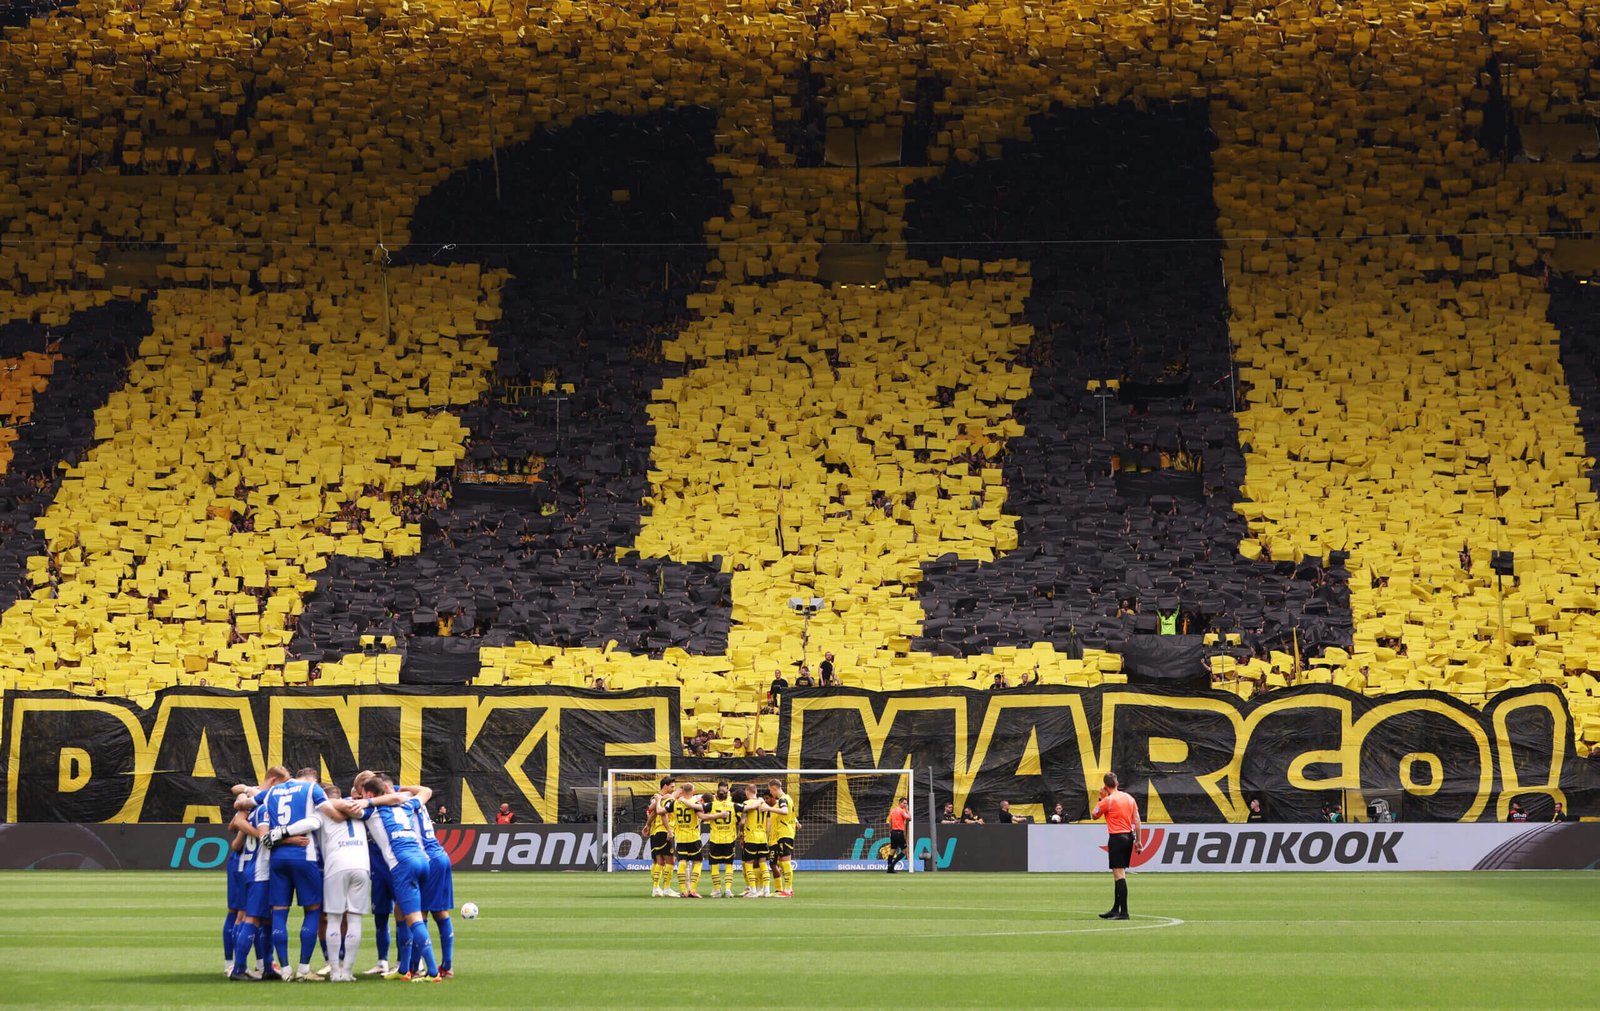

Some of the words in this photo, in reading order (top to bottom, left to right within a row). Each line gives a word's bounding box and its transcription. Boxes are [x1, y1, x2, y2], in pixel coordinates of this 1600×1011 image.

[8, 695, 675, 825] DANKE
[784, 688, 1568, 825] MARCO!
[277, 795, 293, 825] 5
[676, 807, 692, 823] 26
[170, 827, 229, 868] io
